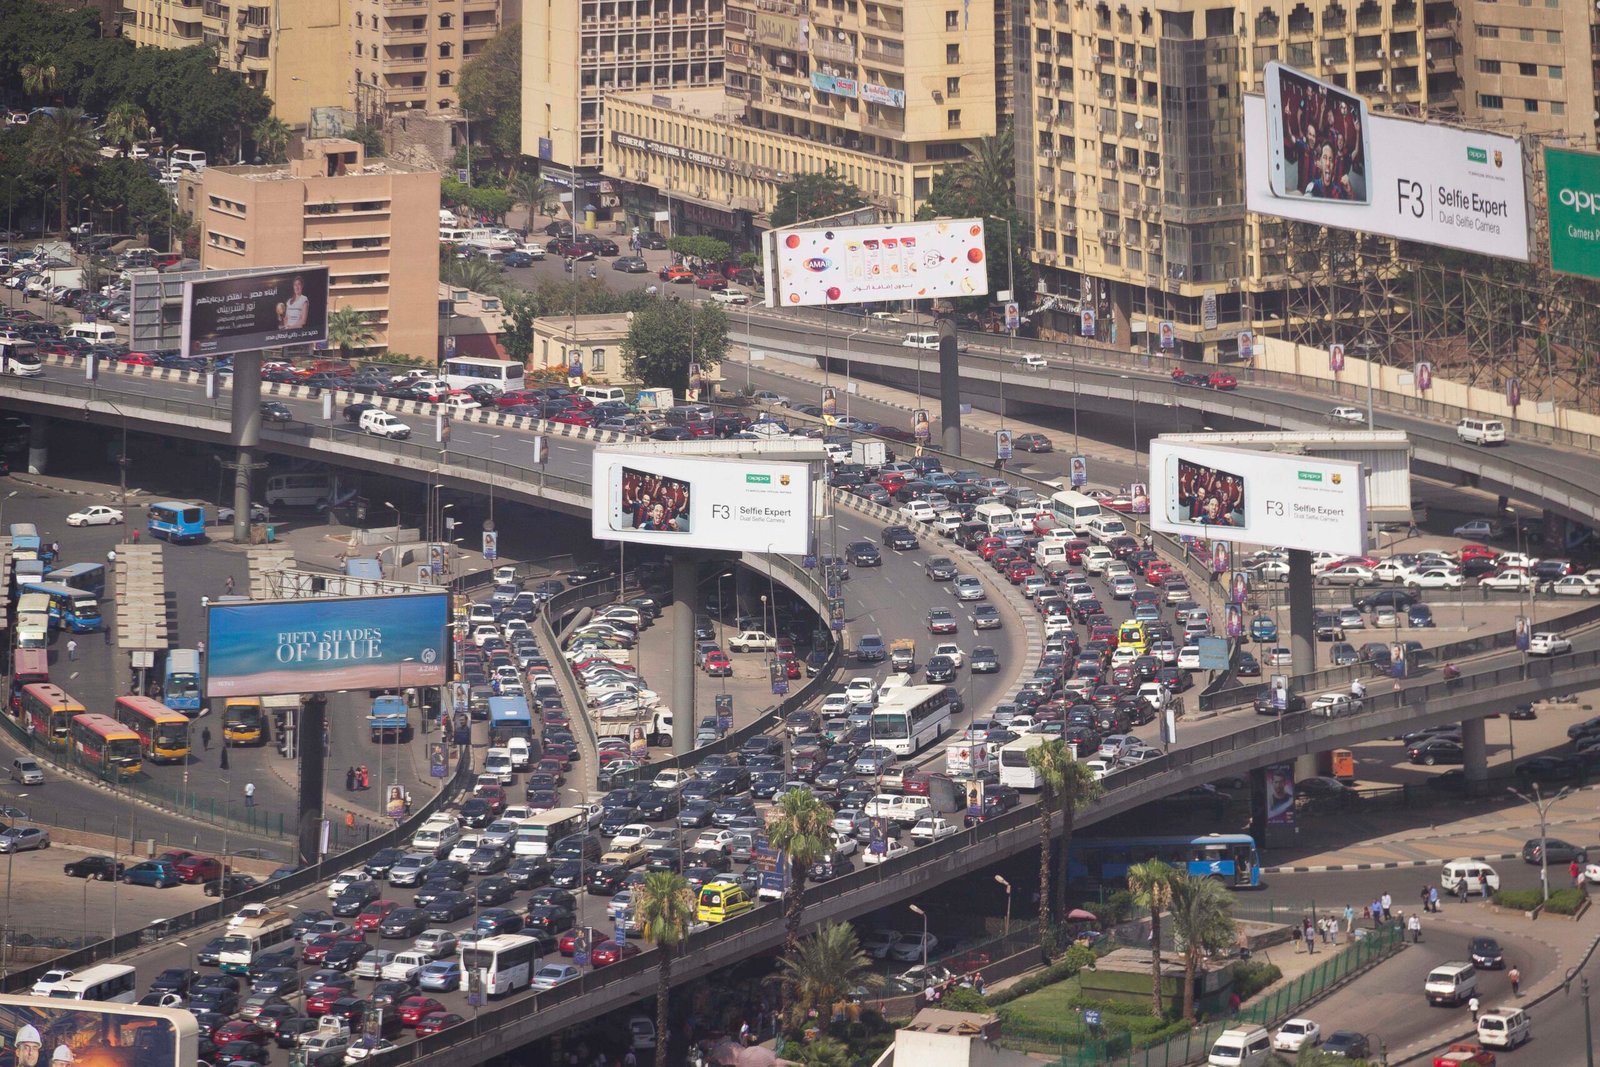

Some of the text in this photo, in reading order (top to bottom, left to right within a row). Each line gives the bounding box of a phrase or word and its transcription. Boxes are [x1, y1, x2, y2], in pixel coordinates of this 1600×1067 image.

[618, 135, 646, 150] GENERAL
[688, 151, 726, 168] CHEMICALS
[1398, 178, 1424, 218] F3
[1438, 186, 1508, 219] Selfie Expert
[1440, 211, 1500, 235] Dual Selfie Camera
[1568, 224, 1594, 240] Camera
[712, 504, 730, 520] F3
[740, 506, 791, 518] Selfie Expert
[1266, 500, 1284, 516] F3
[1294, 504, 1344, 516] Selfie Expert
[278, 628, 382, 644] FIFTY SHADES
[276, 639, 382, 662] OF BLUE
